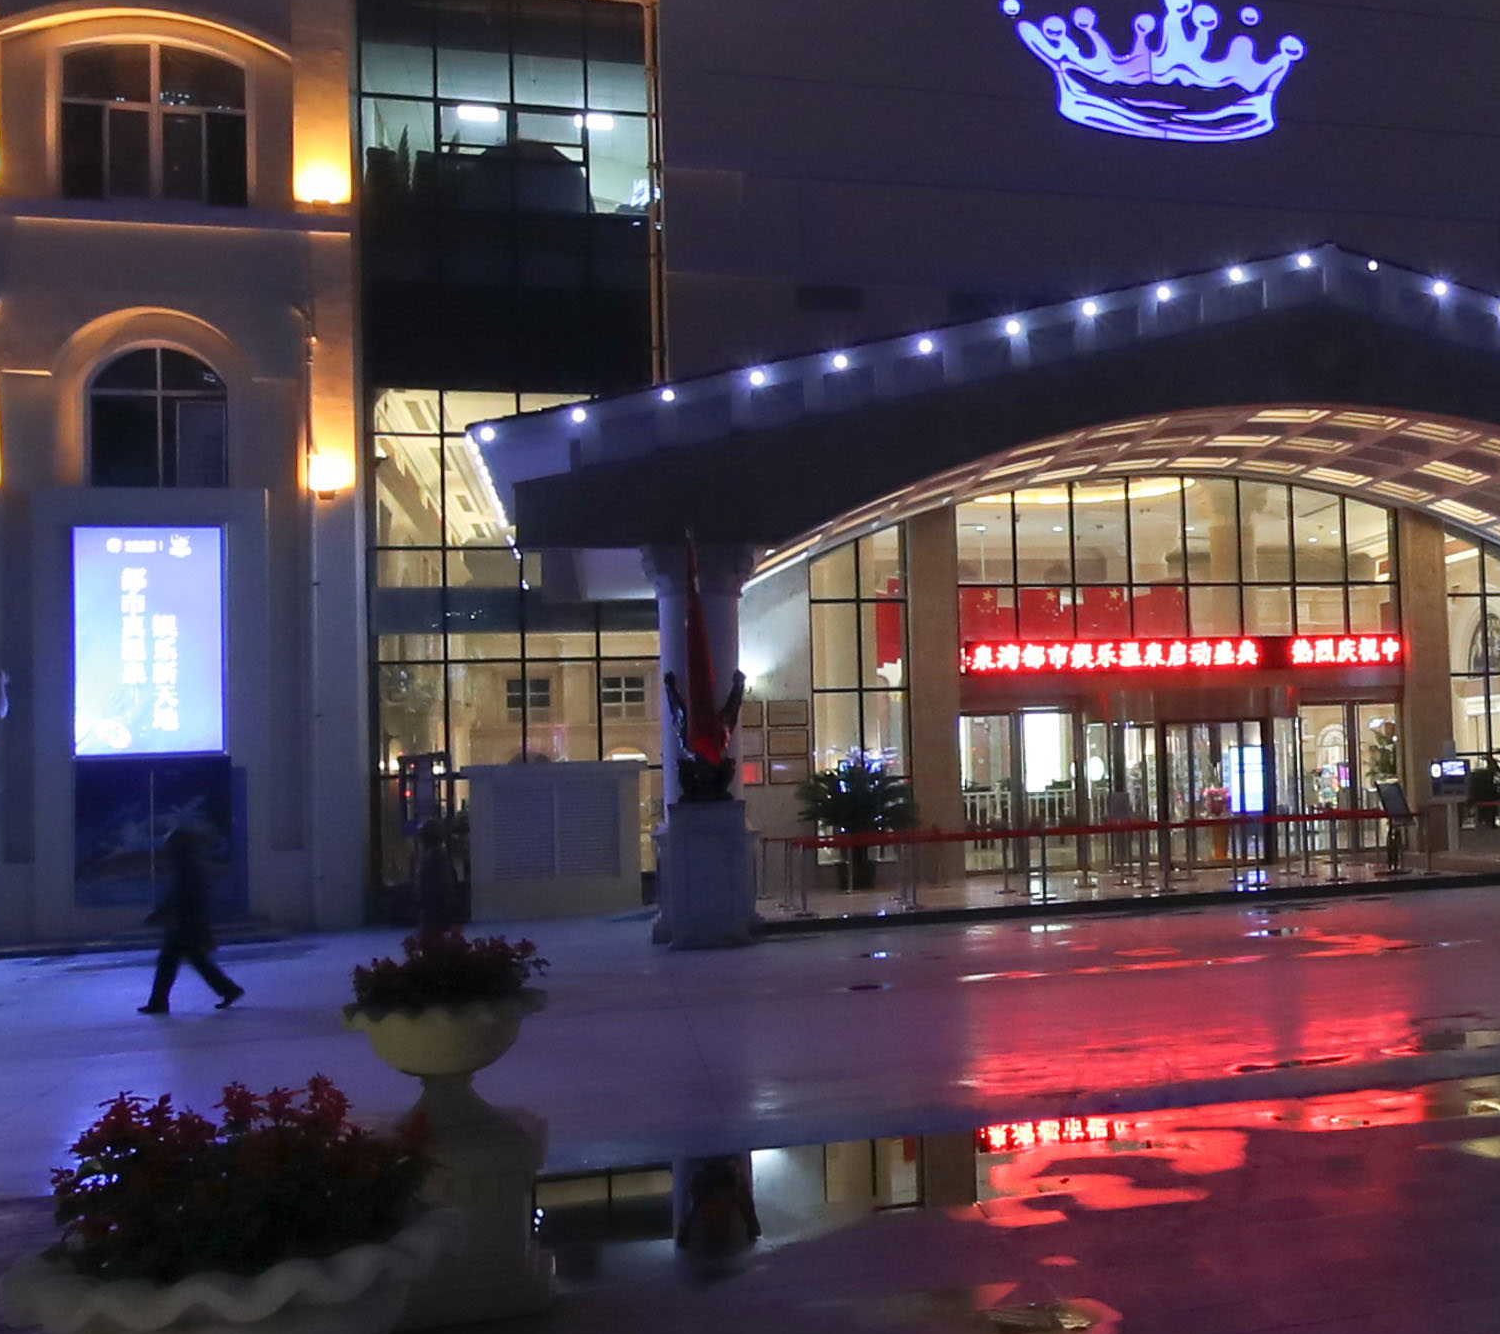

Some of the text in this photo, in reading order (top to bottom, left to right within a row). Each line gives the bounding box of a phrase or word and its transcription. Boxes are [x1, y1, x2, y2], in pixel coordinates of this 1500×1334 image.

[966, 639, 1259, 671] 泉湾都市娱乐温泉启动盛典
